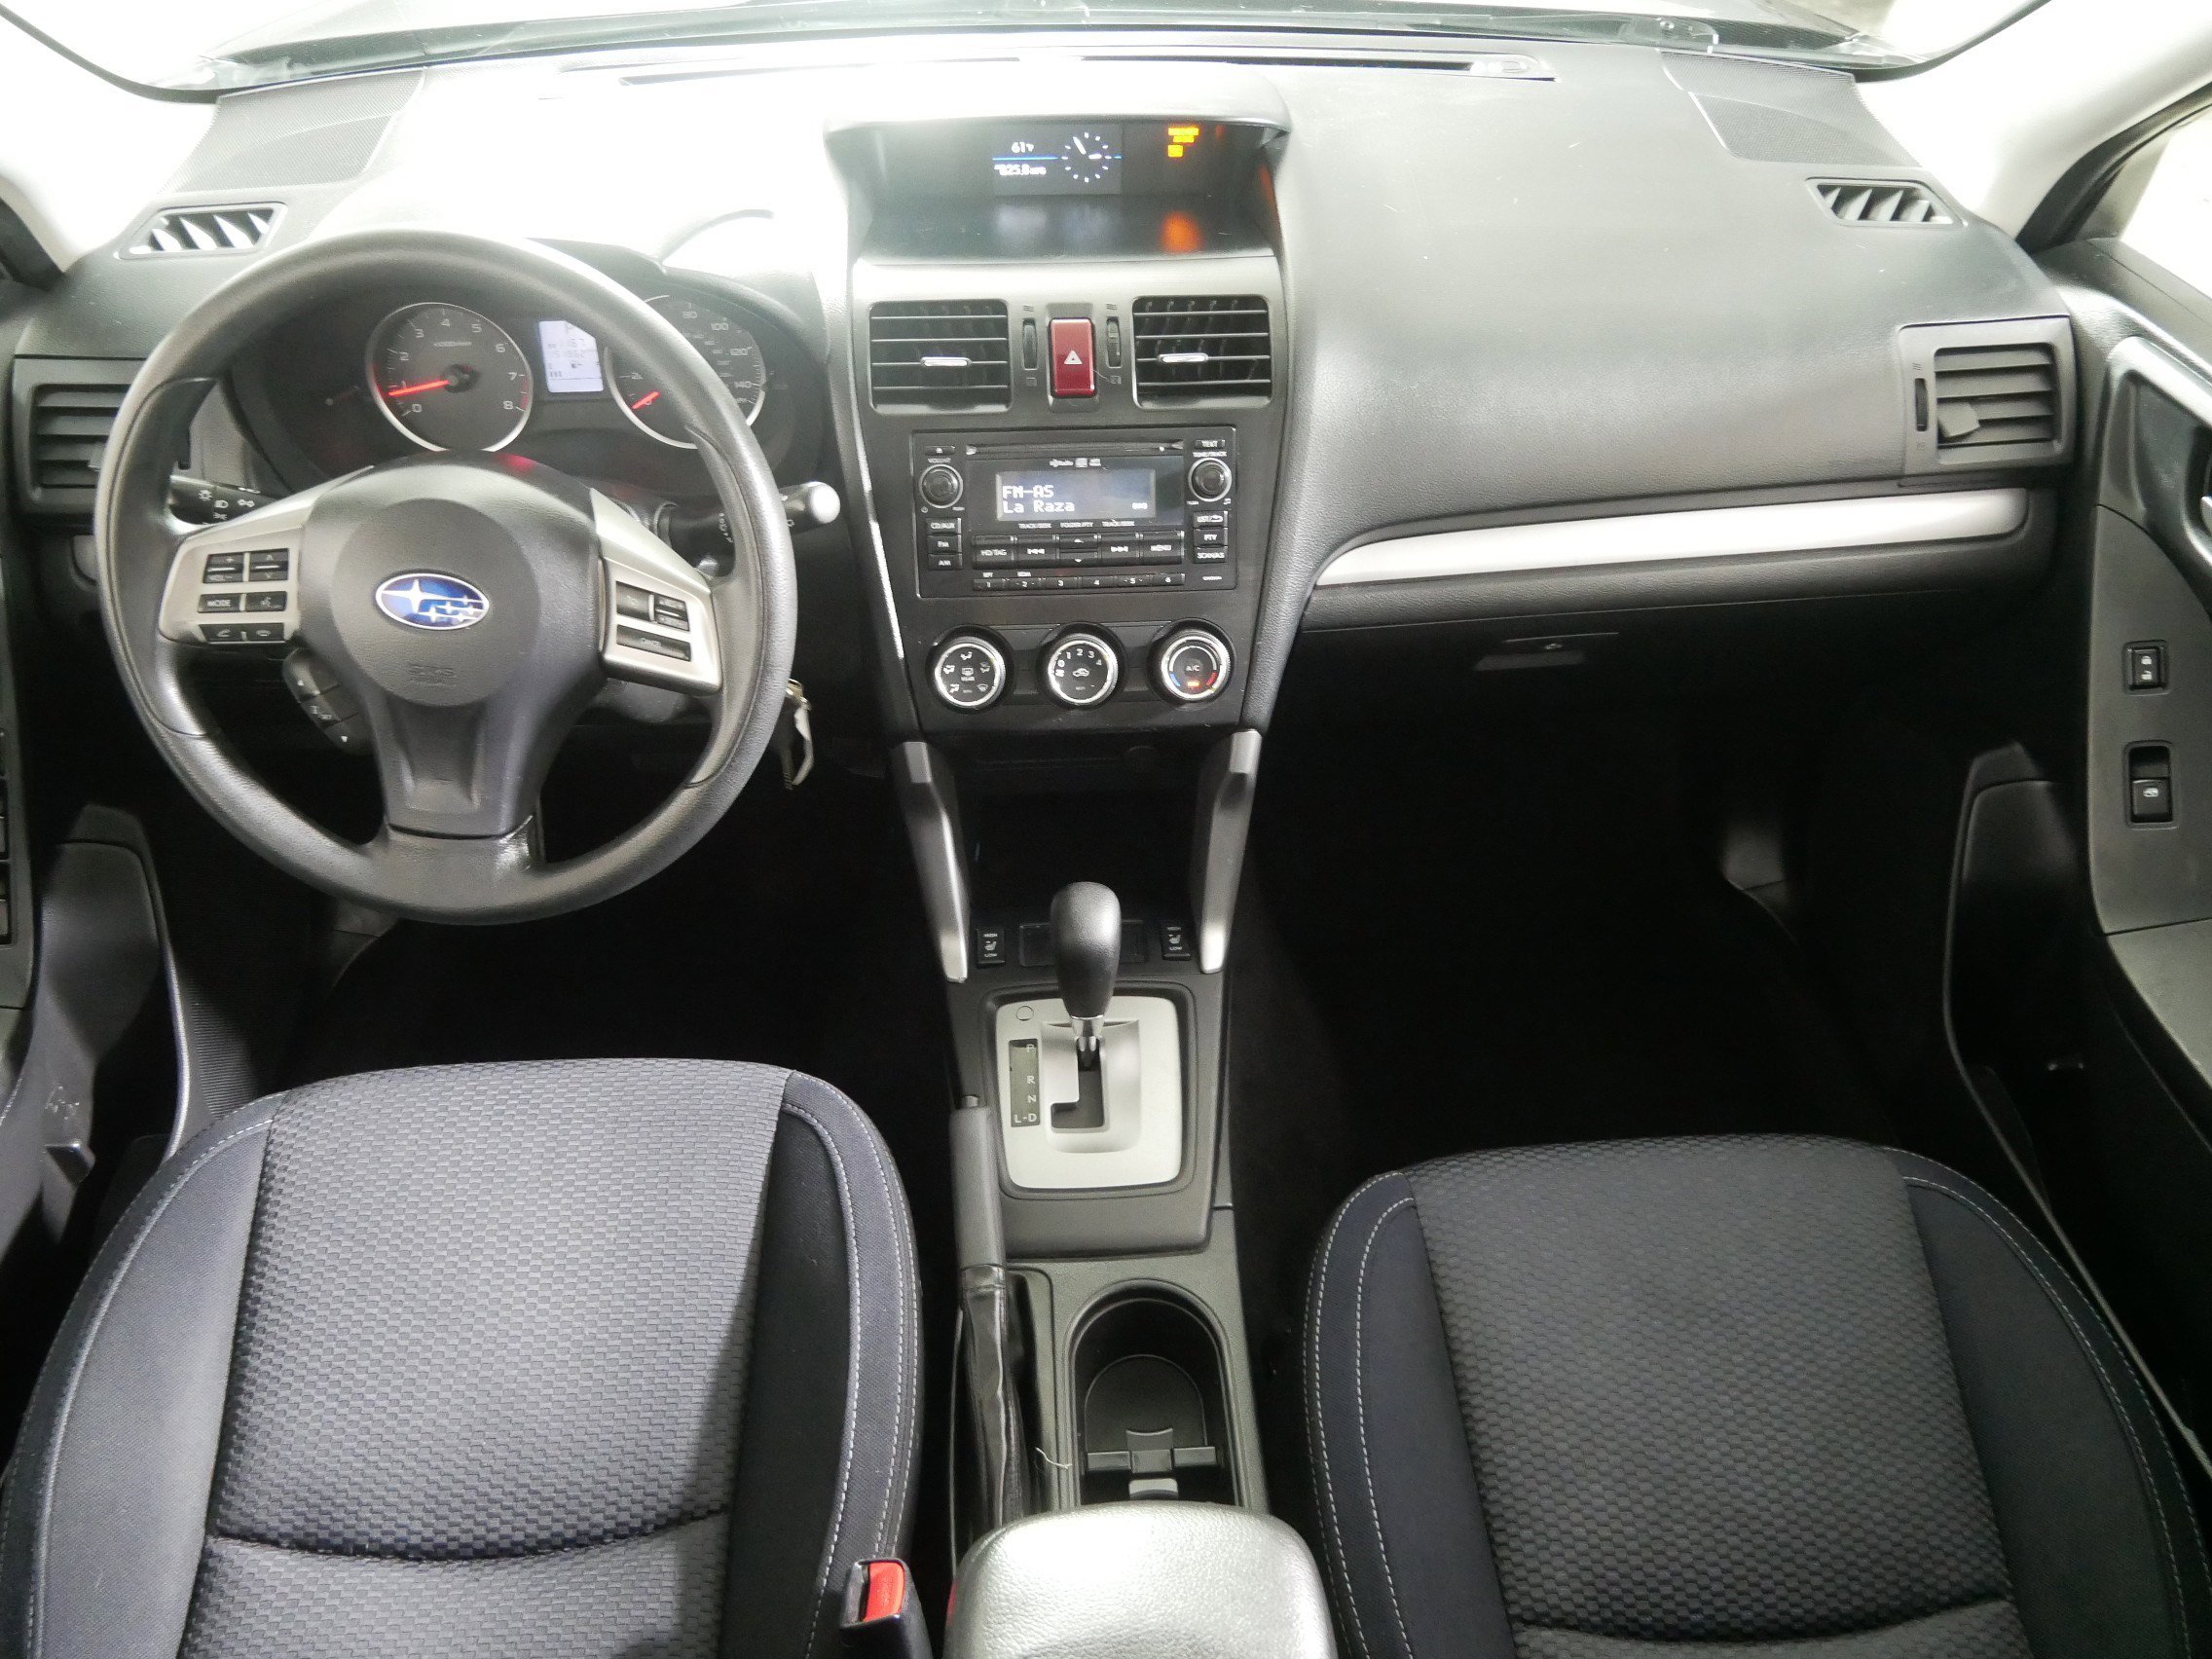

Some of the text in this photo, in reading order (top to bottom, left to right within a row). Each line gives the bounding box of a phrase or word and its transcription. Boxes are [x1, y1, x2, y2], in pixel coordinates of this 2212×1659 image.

[440, 318, 451, 327] 4
[711, 322, 729, 331] 100
[471, 323, 483, 333] 5
[415, 329, 424, 339] 3
[495, 344, 506, 353] 6
[399, 351, 410, 361] 2
[508, 372, 518, 381] 7
[412, 403, 423, 413] 0
[502, 400, 514, 410] 8
[1002, 484, 1054, 498] FM-AS
[1002, 499, 1075, 514] La Raza
[206, 599, 232, 608] MODE
[1066, 651, 1071, 660] 1
[1088, 650, 1095, 659] 3
[1026, 1044, 1035, 1052] P
[1026, 1075, 1036, 1085] R
[1027, 1094, 1037, 1104] N
